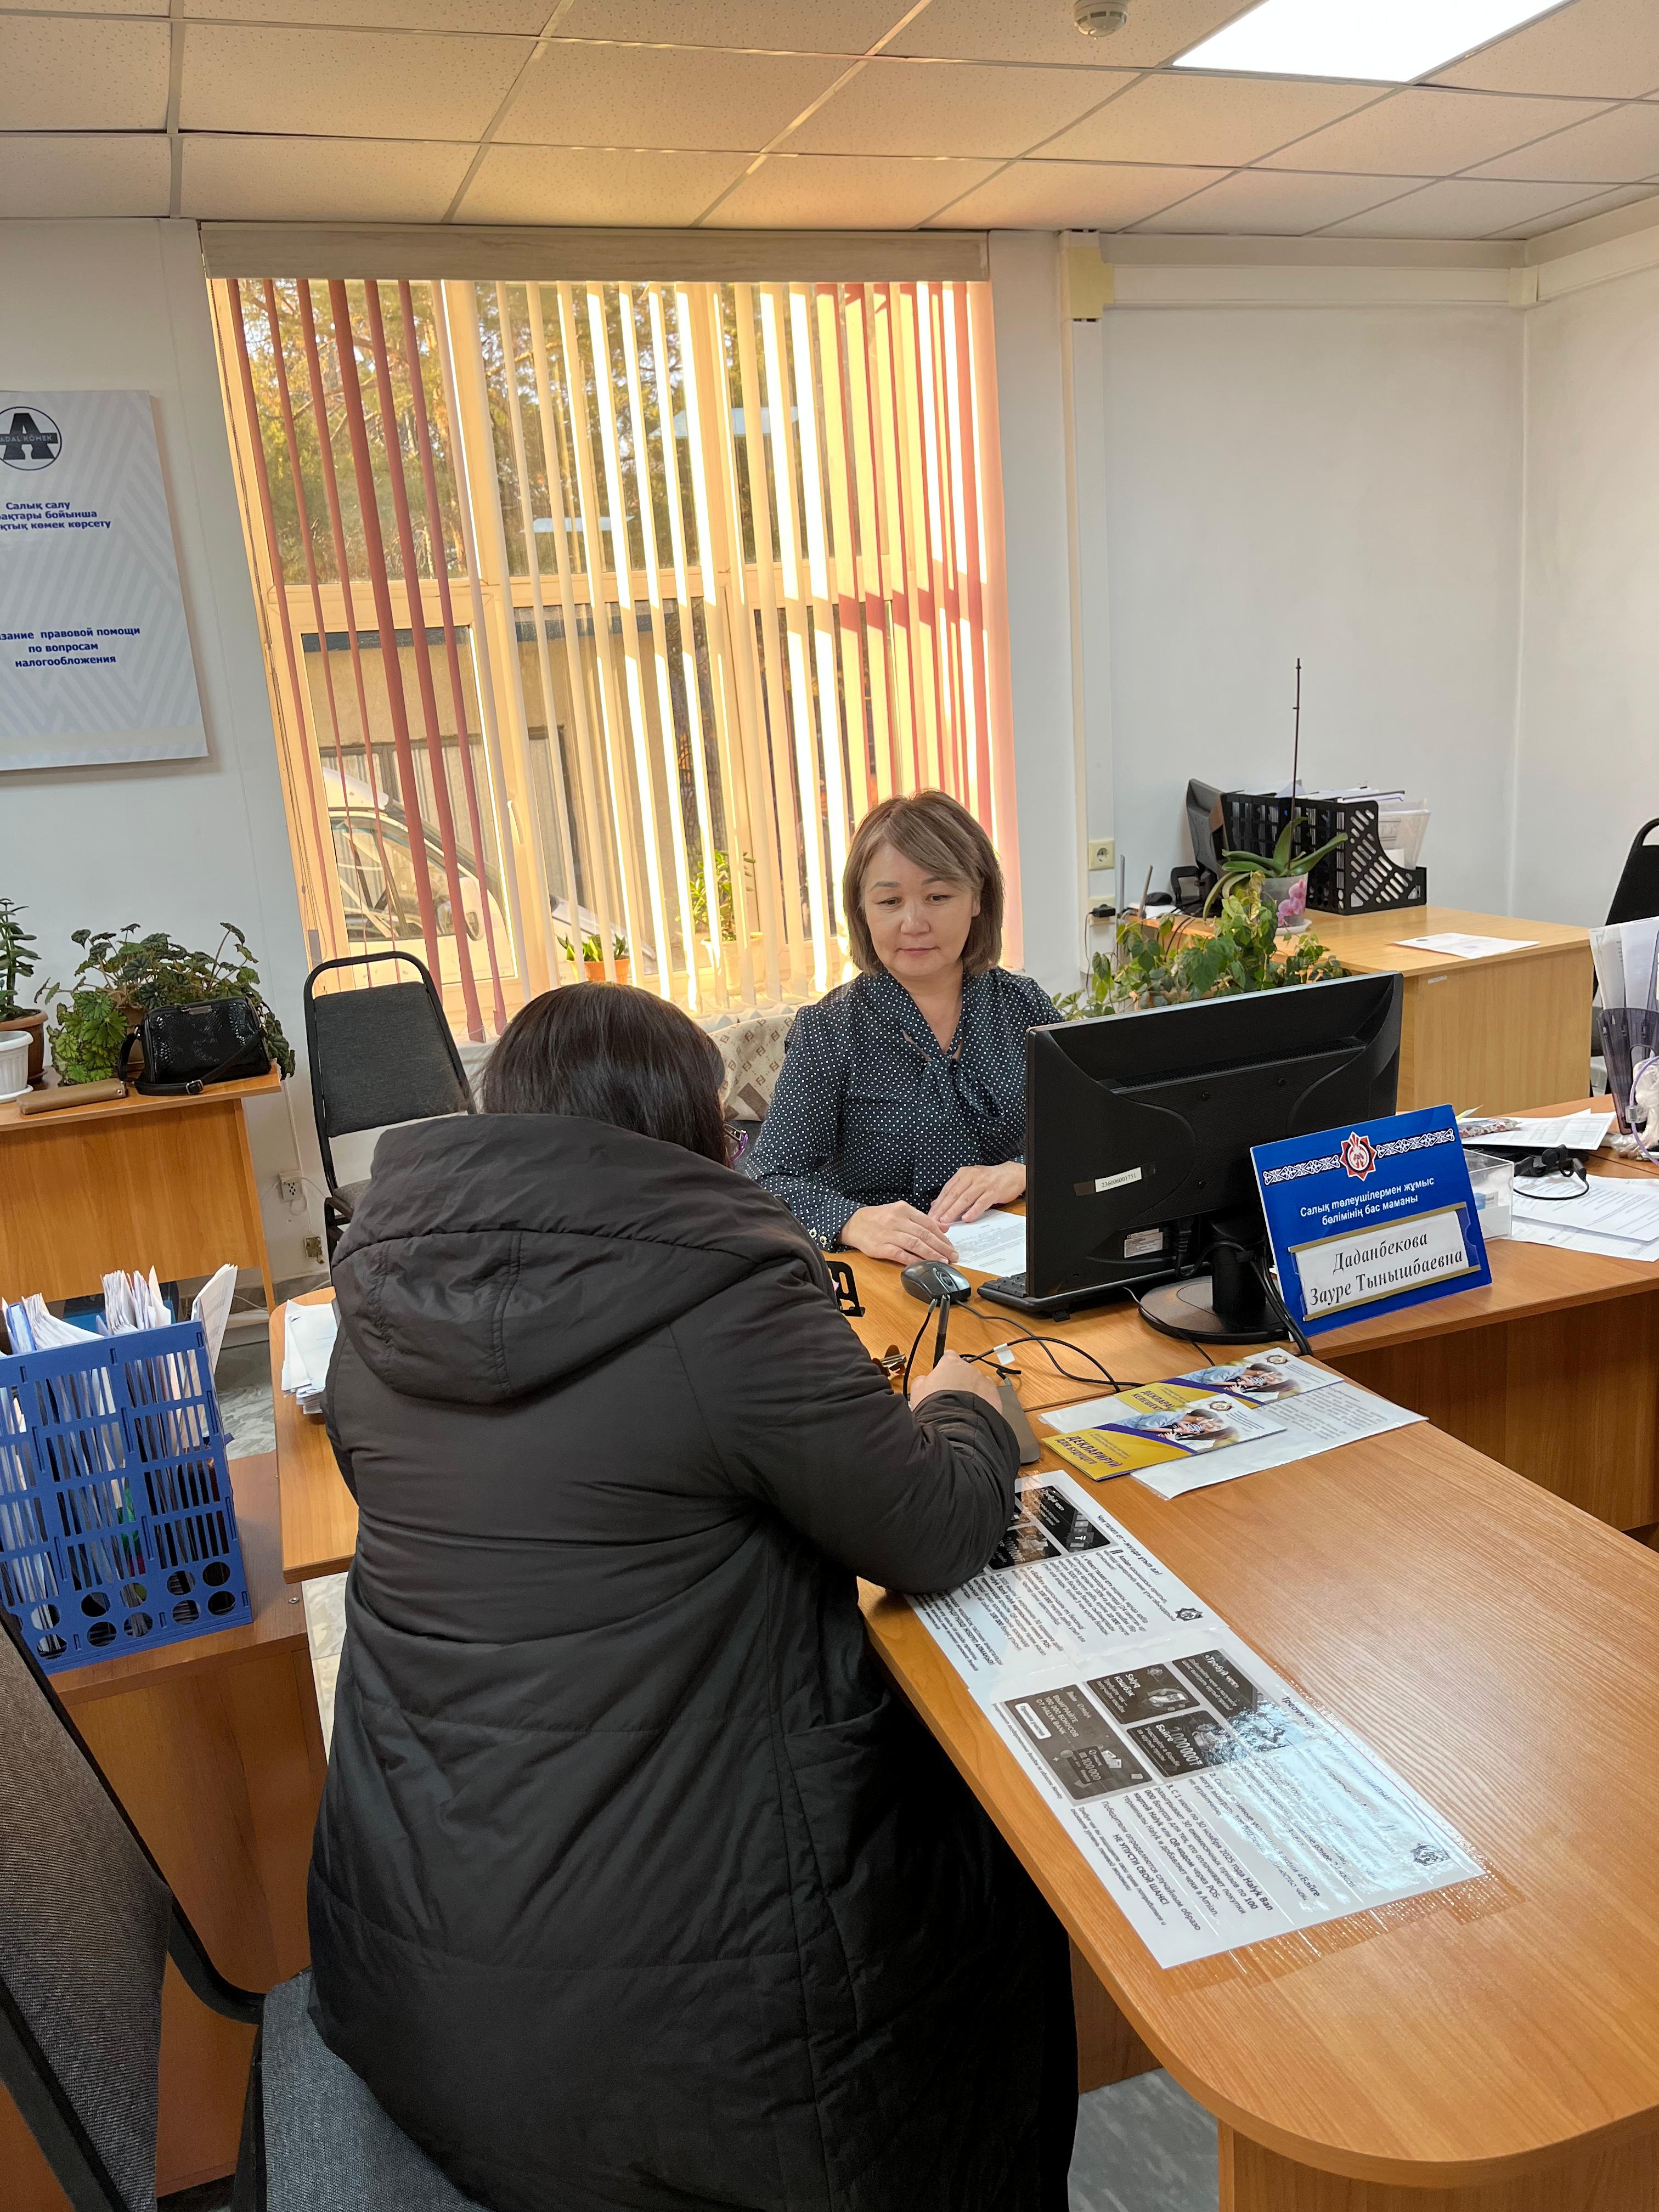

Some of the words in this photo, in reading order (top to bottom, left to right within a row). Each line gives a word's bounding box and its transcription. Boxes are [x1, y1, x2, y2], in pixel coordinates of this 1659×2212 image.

[45, 510, 97, 519] бойынша
[69, 521, 111, 529] көрсету
[41, 628, 93, 640] правовой
[97, 627, 140, 636] помощи
[46, 642, 98, 653] вопросам
[15, 656, 116, 668] налогообложения
[1300, 1203, 1330, 1217] Салық
[1331, 1185, 1402, 1210] төлеушілермен
[1403, 1177, 1434, 1192] жұмыс
[1322, 1208, 1363, 1226] бөлімінің
[1364, 1203, 1380, 1215] бас
[1382, 1194, 1418, 1210] маманы
[1332, 1234, 1427, 1275] Даданбекова
[1310, 1283, 1351, 1306] Зауре
[1356, 1251, 1463, 1292] Тынышбаевна
[1054, 1438, 1071, 1447] ДЛЯ
[1065, 1436, 1124, 1468] ДЕКЛАРИРУЙ
[1125, 1673, 1141, 1688] Salyq
[1041, 1706, 1056, 1721] HALYK
[1052, 1721, 1066, 1734] BANK
[1044, 1696, 1054, 1705] 100
[1051, 1705, 1061, 1714] 000
[1057, 1714, 1079, 1737] БОНУСОВ
[1052, 1695, 1078, 1723] ВЫИГРАЙТЕ
[1101, 1801, 1128, 1832] Победители
[1125, 1833, 1158, 1873] определяются
[1155, 1874, 1183, 1907] случайным
[1122, 1795, 1148, 1825] терминалы
[1145, 1825, 1161, 1840] Halyk
[1159, 1846, 1187, 1874] добавляет
[1184, 1875, 1199, 1889] чеки
[1199, 1895, 1218, 1916] Amian.
[1133, 1792, 1152, 1811] картой
[1148, 1812, 1164, 1826] Halyk
[1160, 1827, 1172, 1837] или
[1169, 1838, 1195, 1867] QR-кодом
[1192, 1867, 1209, 1884] через
[1205, 1885, 1221, 1899] POS-
[1144, 1790, 1156, 1799] 000
[1152, 1800, 1172, 1821] бонусов
[1167, 1822, 1181, 1832] для
[1178, 1832, 1189, 1843] тех,
[1186, 1844, 1198, 1853] кто
[1195, 1854, 1225, 1887] оплачивает
[1221, 1888, 1246, 1914] покупки
[1153, 1787, 1184, 1819] разыгрывает
[1188, 1828, 1221, 1865] ежемесячных
[1218, 1866, 1239, 1888] призов
[1244, 1898, 1258, 1909] 100
[1177, 1798, 1193, 1813] июня
[1202, 1829, 1222, 1848] ноября
[1219, 1849, 1235, 1863] 2025
[1231, 1864, 1245, 1877] года
[1242, 1877, 1262, 1897] Halyk
[1119, 1842, 1140, 1865] УПУСТИ
[1136, 1866, 1154, 1883] СВОЙ
[1148, 1883, 1170, 1904] ШАНС!
